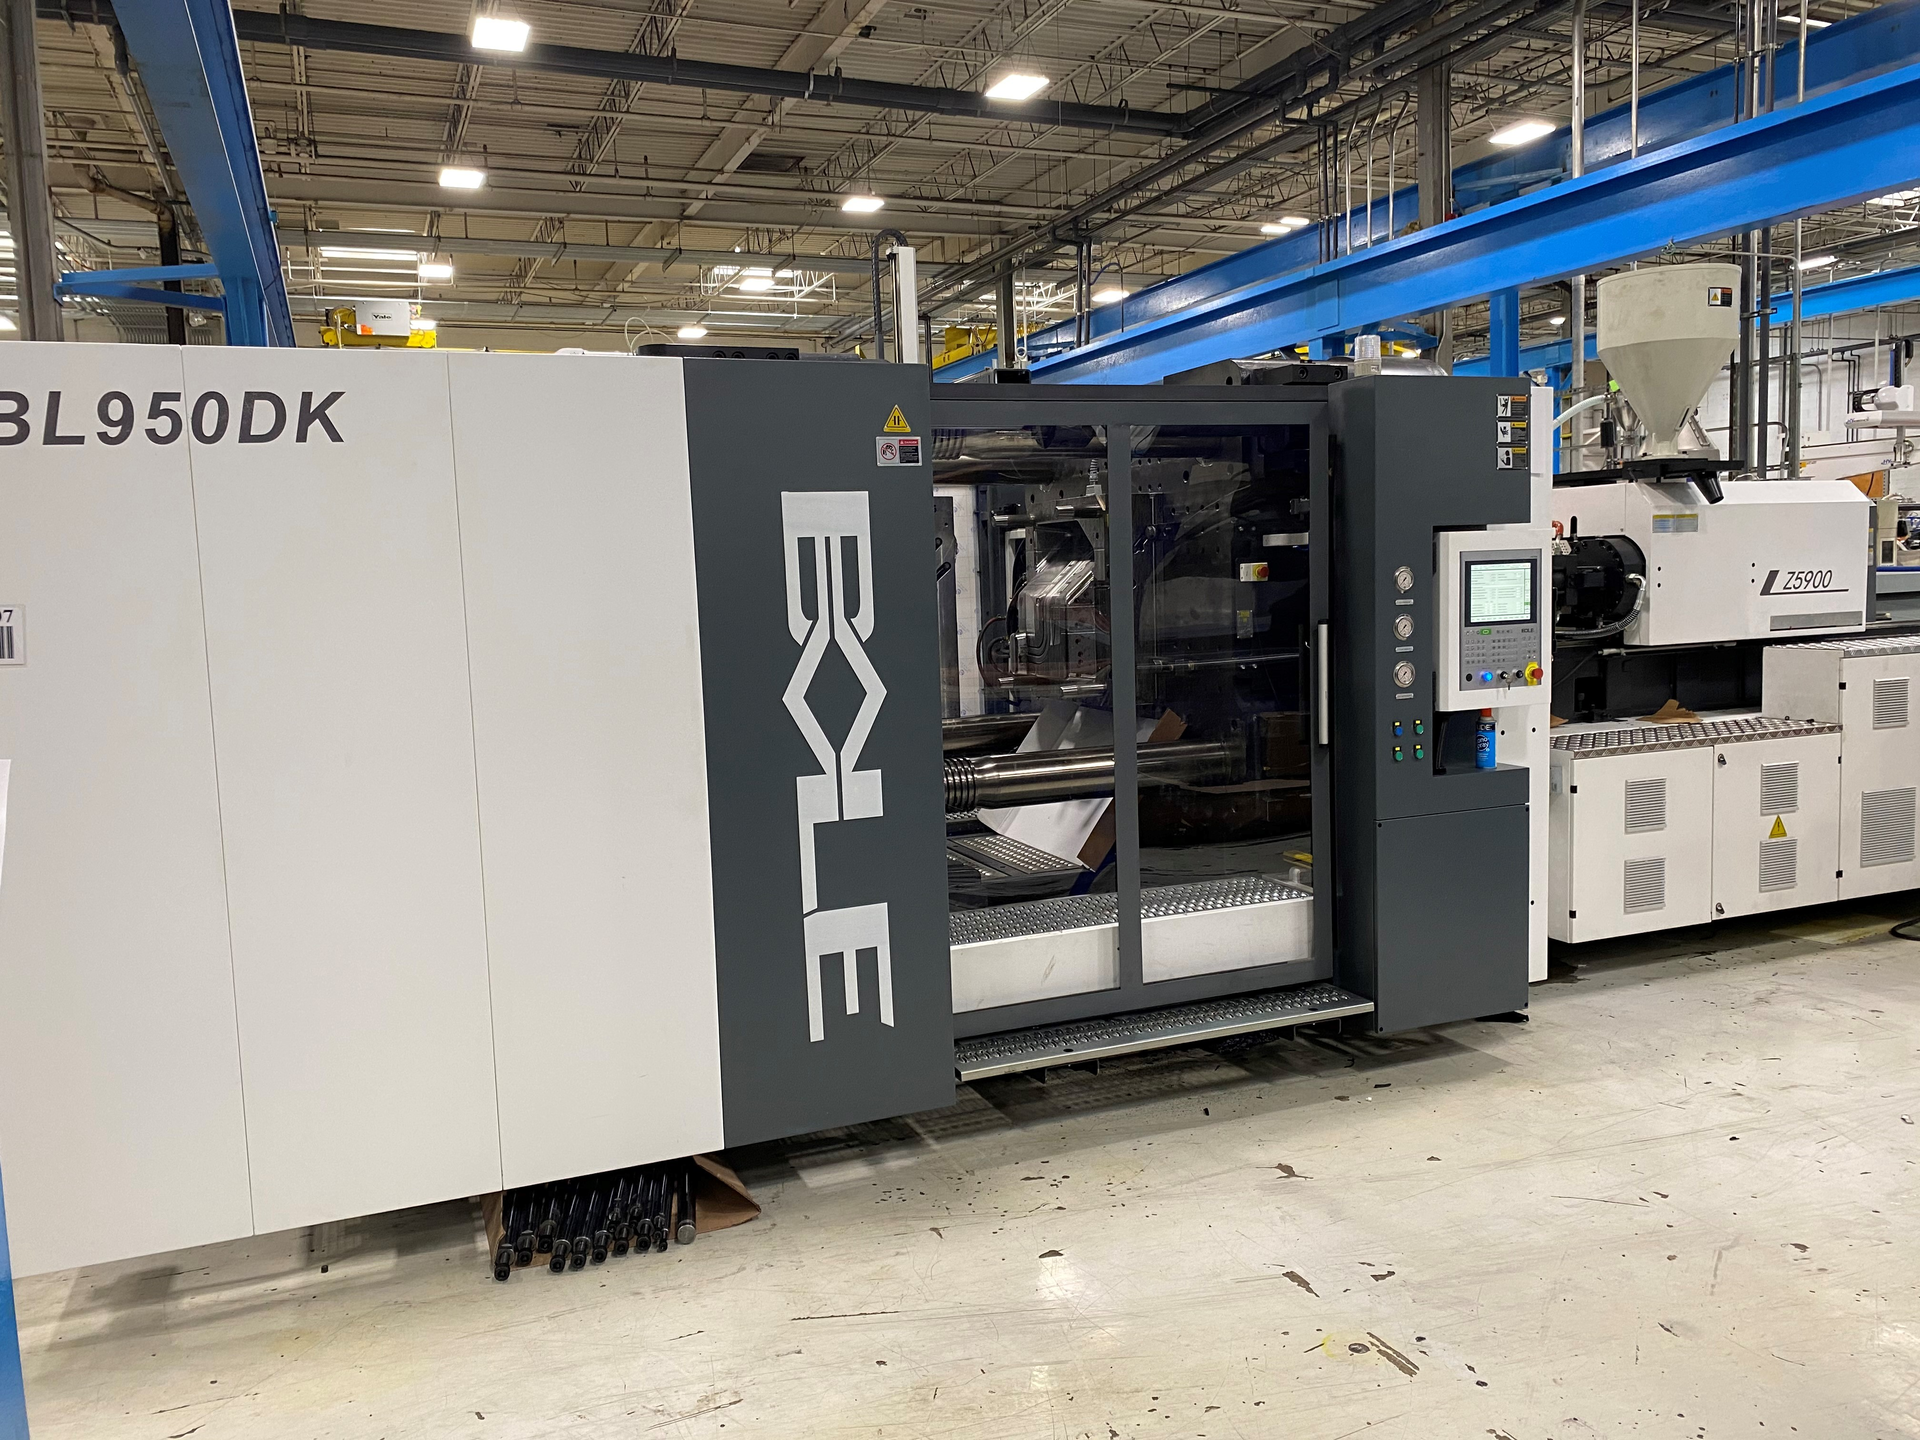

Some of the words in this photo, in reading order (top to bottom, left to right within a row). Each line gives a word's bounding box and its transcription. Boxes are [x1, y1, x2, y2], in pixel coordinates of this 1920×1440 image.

[0, 390, 346, 445] BL950DK
[1782, 569, 1833, 591] Z5900
[0, 609, 14, 623] 7
